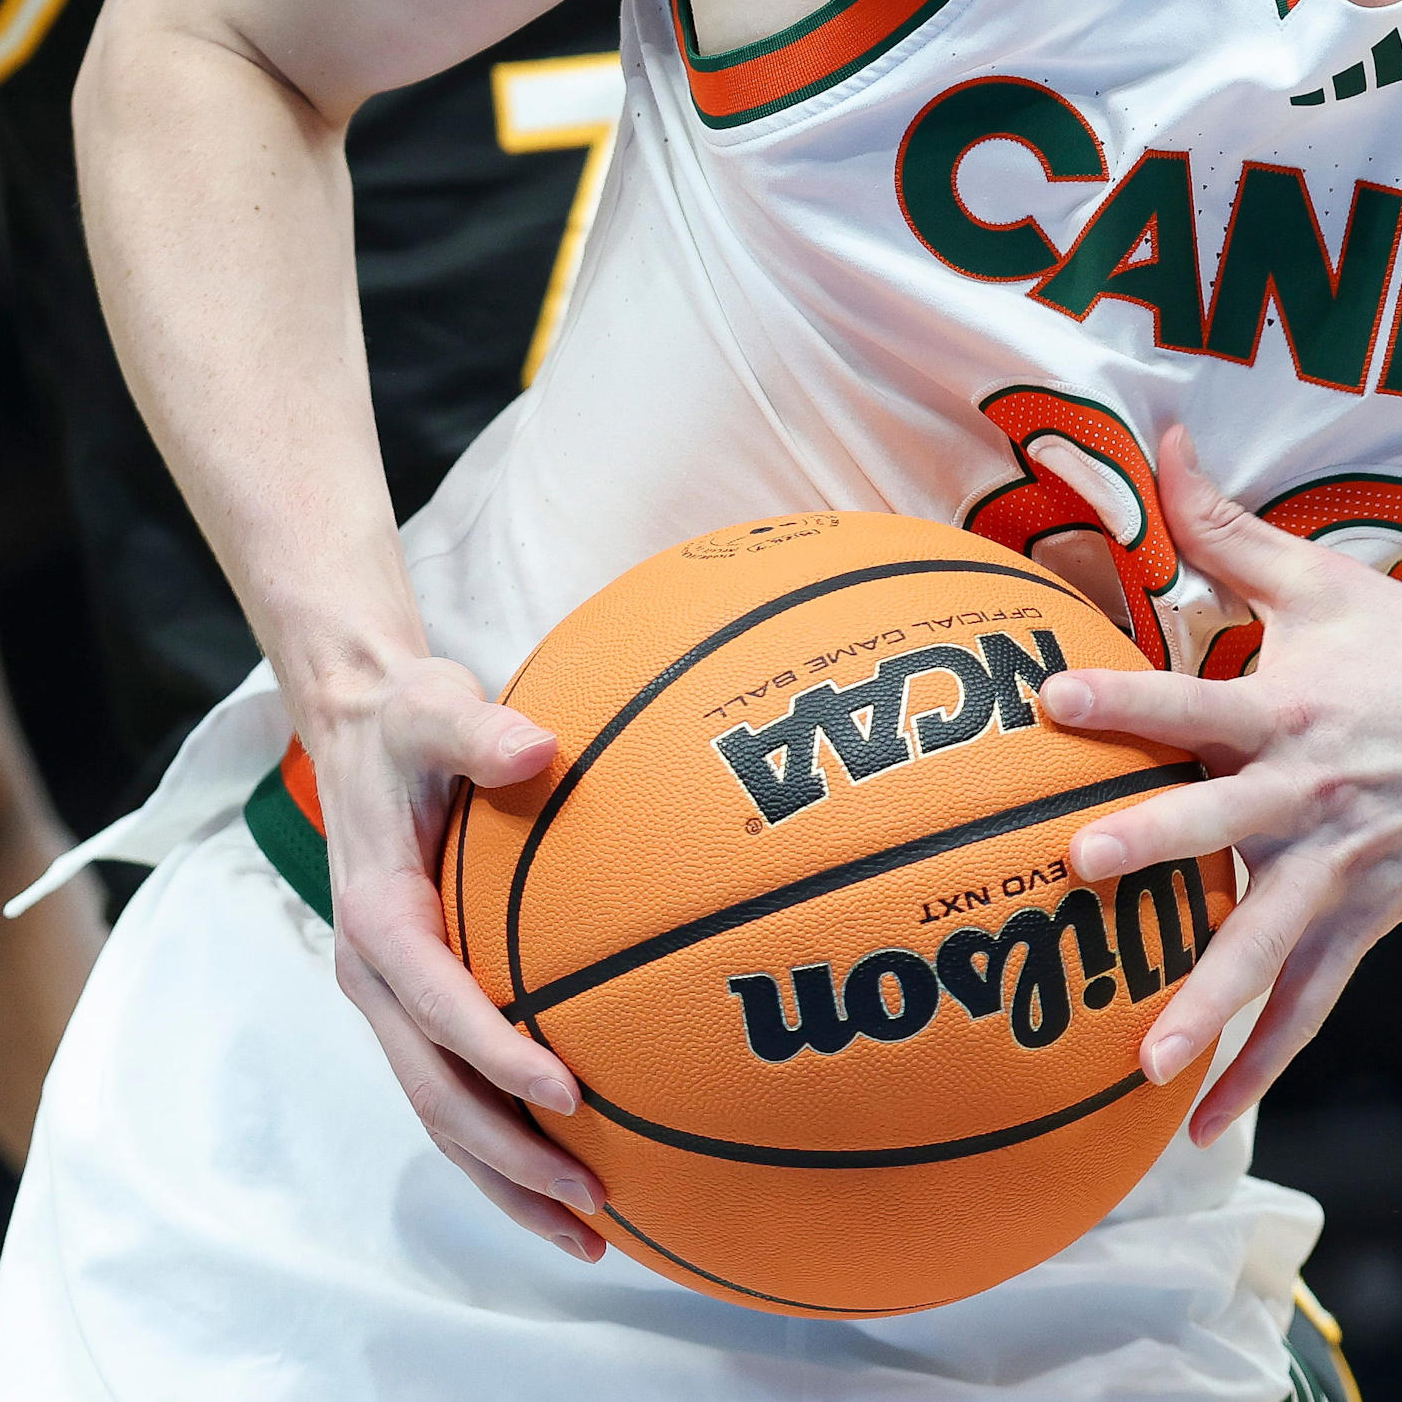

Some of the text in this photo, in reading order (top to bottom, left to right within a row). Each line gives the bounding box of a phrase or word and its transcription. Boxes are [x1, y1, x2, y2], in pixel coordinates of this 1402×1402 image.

[702, 606, 1044, 719] OFFICIAL GAME BALL
[710, 628, 1069, 829] NCAA
[726, 856, 1211, 1064] Wilson
[919, 859, 1069, 924] EVO NXT
